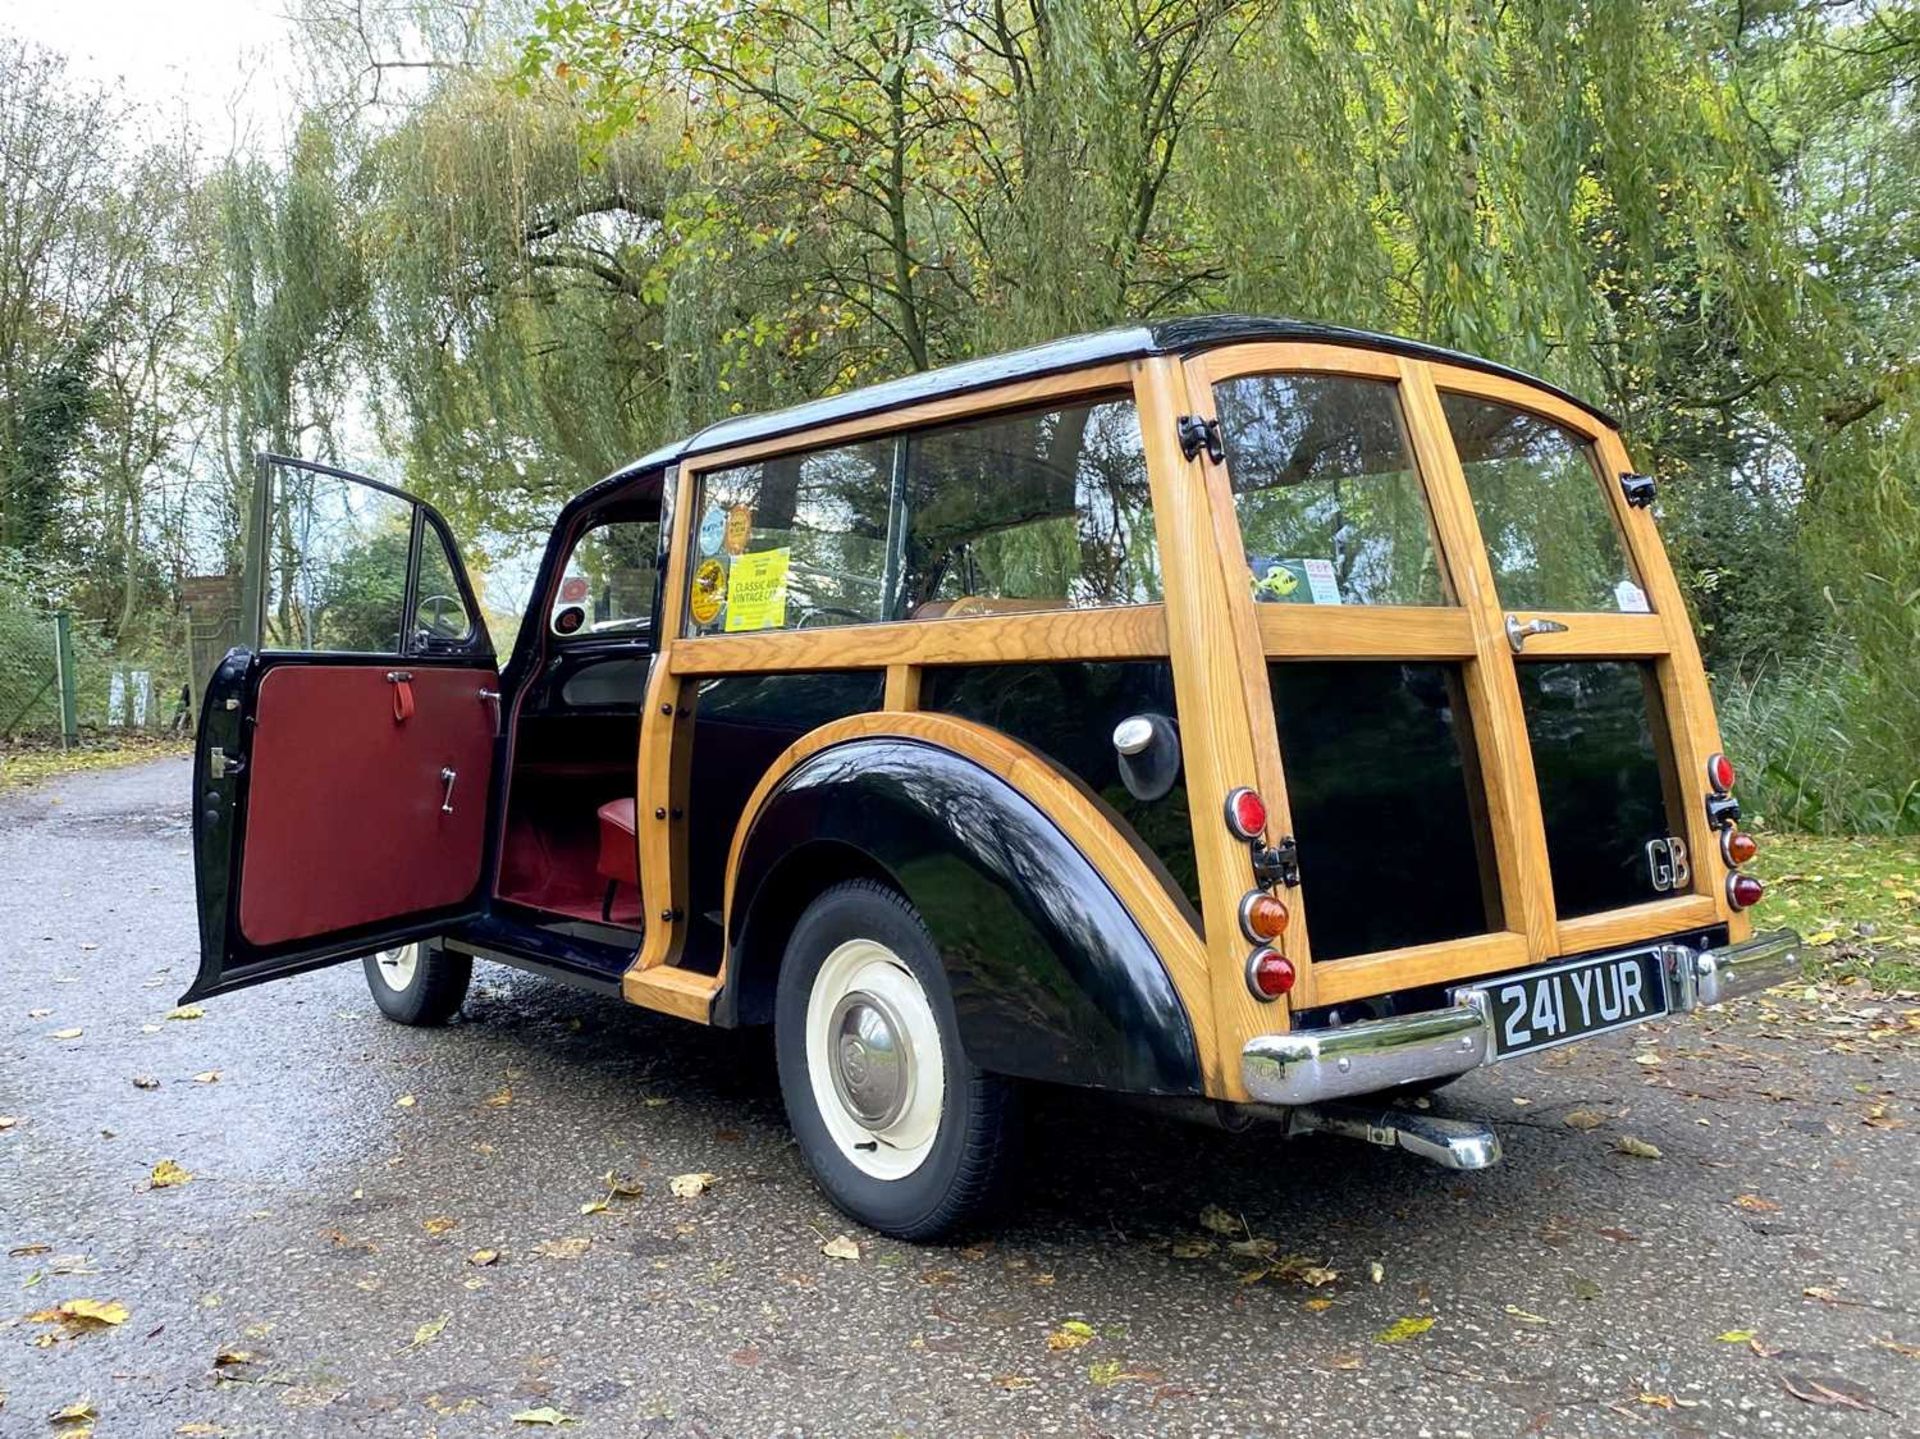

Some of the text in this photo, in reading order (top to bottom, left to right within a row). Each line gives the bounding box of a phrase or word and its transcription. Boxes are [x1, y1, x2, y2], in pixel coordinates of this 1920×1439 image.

[733, 590, 763, 603] VINTAGE
[735, 581, 766, 593] CLASSIC
[1645, 837, 1690, 892] GB
[1501, 960, 1646, 1047] 241 YUR
